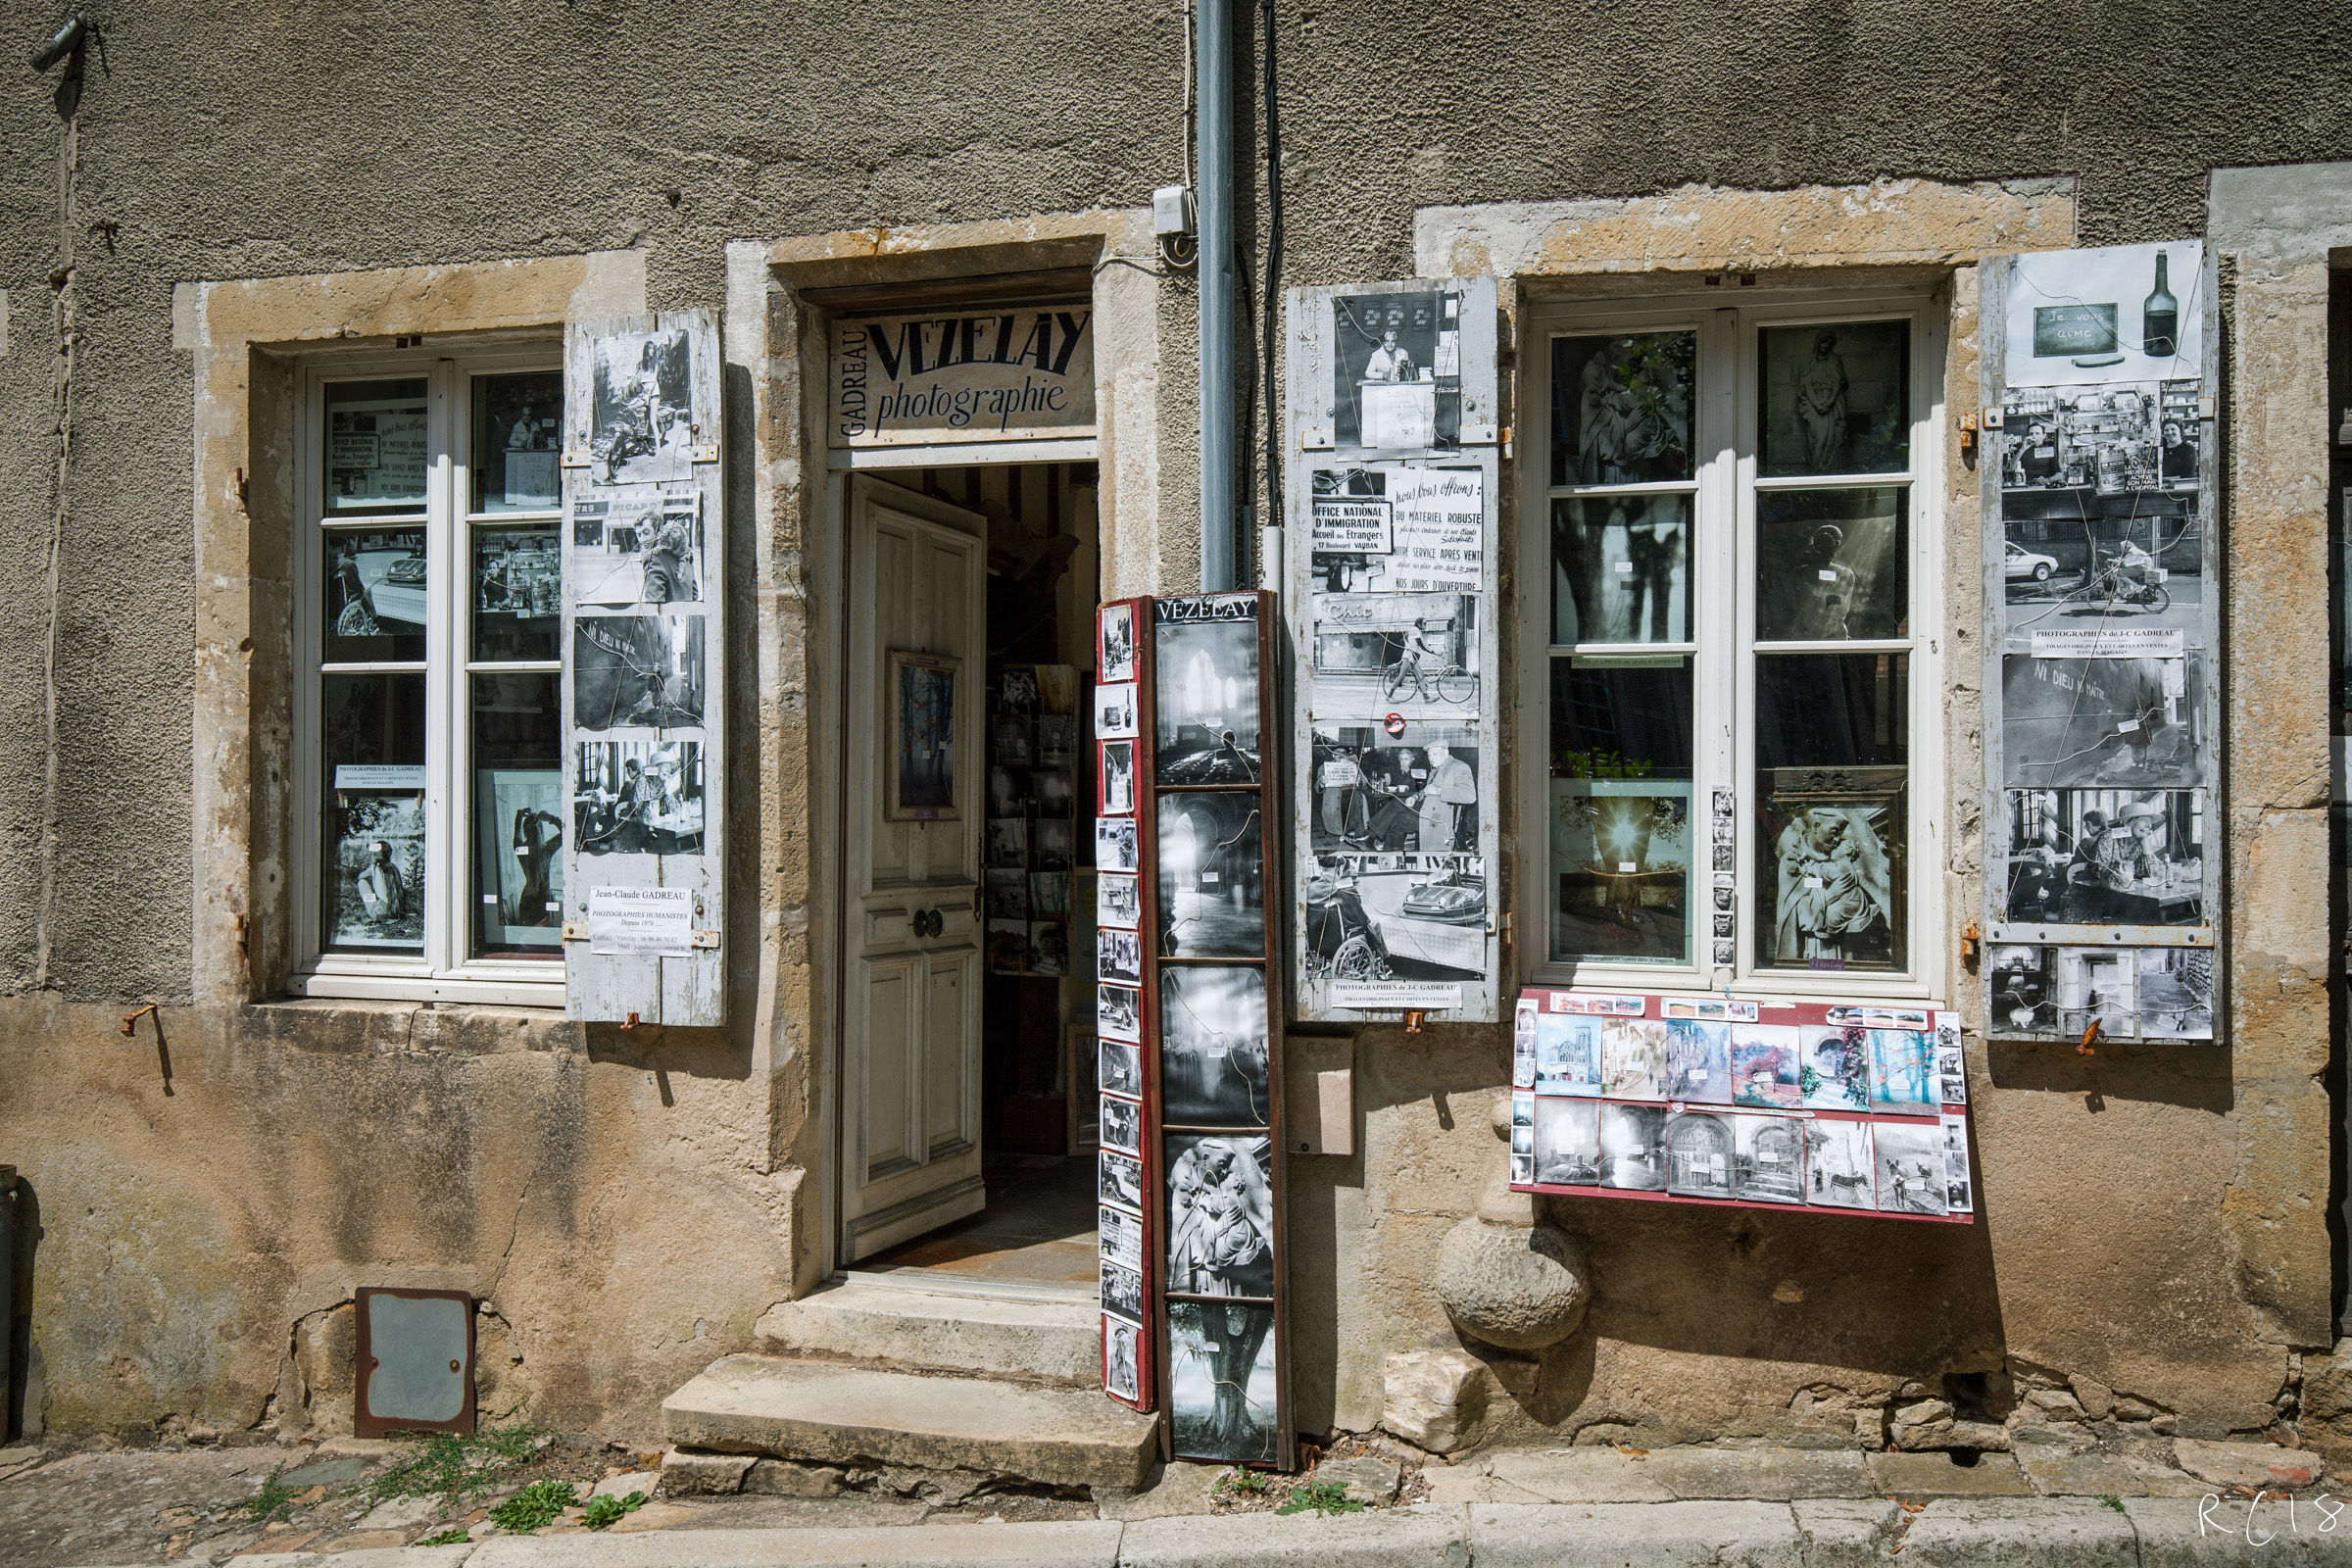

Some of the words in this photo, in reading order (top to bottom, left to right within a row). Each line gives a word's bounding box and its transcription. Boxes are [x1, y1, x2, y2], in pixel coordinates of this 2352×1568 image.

[2048, 311, 2065, 322] Je
[2077, 313, 2104, 321] vous
[864, 311, 1092, 382] VEZELAY
[840, 329, 867, 437] GADREAU
[873, 375, 1069, 439] photographie
[574, 504, 595, 513] URS
[612, 502, 658, 512] PICARD
[1312, 506, 1341, 516] OFFICE
[1344, 507, 1384, 517] NATIONAL
[1315, 517, 1380, 528] D'IMMIGRATION
[1396, 511, 1405, 521] DU
[1447, 513, 1481, 524] ROBUSTE
[1312, 529, 1335, 539] Accueil
[1347, 529, 1384, 541] Etrangers
[1412, 548, 1437, 559] SERVICE
[1396, 577, 1407, 589] NOS
[1411, 578, 1429, 590] JOURS
[1157, 598, 1253, 620] VEZELAY
[1328, 605, 1373, 619] Chic
[2035, 629, 2108, 638] PHOTOGRAPHIS
[595, 889, 640, 900] Jean-Claude
[642, 891, 686, 901] GADREAU
